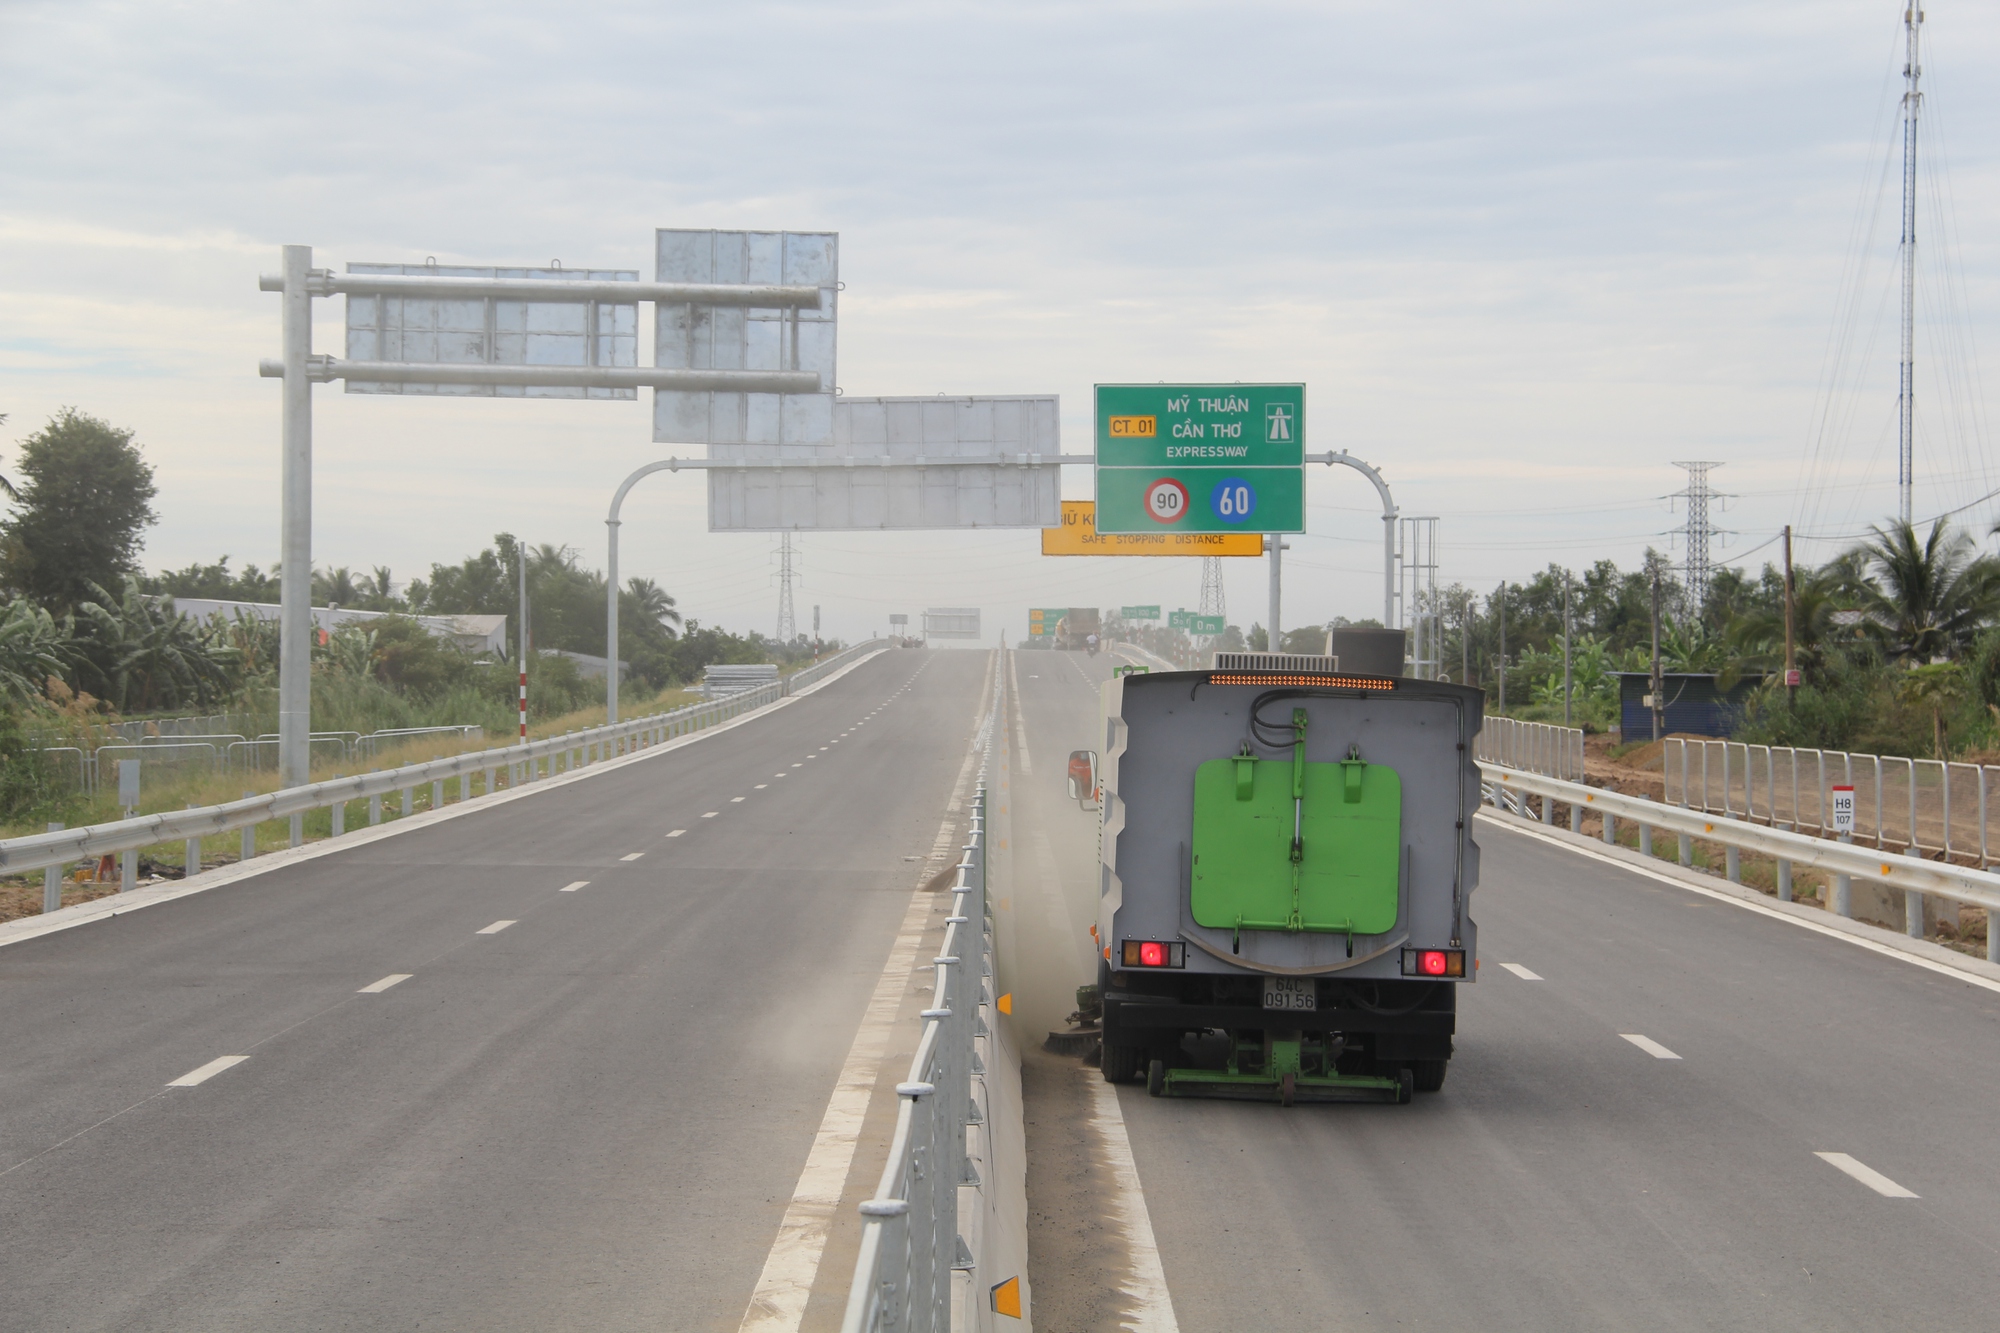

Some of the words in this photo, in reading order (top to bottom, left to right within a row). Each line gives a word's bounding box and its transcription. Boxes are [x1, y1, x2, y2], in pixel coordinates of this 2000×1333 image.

[1167, 394, 1190, 412] MỸ
[1198, 394, 1249, 415] THUẬN
[1172, 418, 1204, 438] CẦN
[1211, 421, 1242, 438] THƠ
[1166, 446, 1248, 458] EXPRESSWAY
[1156, 493, 1178, 509] 90
[1219, 487, 1249, 515] 60
[1060, 509, 1078, 526] IỮ
[1083, 513, 1095, 526] K
[1081, 534, 1107, 544] SAFE
[1116, 534, 1166, 544] STOPPING
[1175, 534, 1225, 545] DISTANCE
[1206, 623, 1215, 631] m
[1835, 798, 1851, 809] H8
[1836, 815, 1850, 824] 107
[1276, 978, 1303, 992] 64C
[1265, 993, 1314, 1008] 091.56
